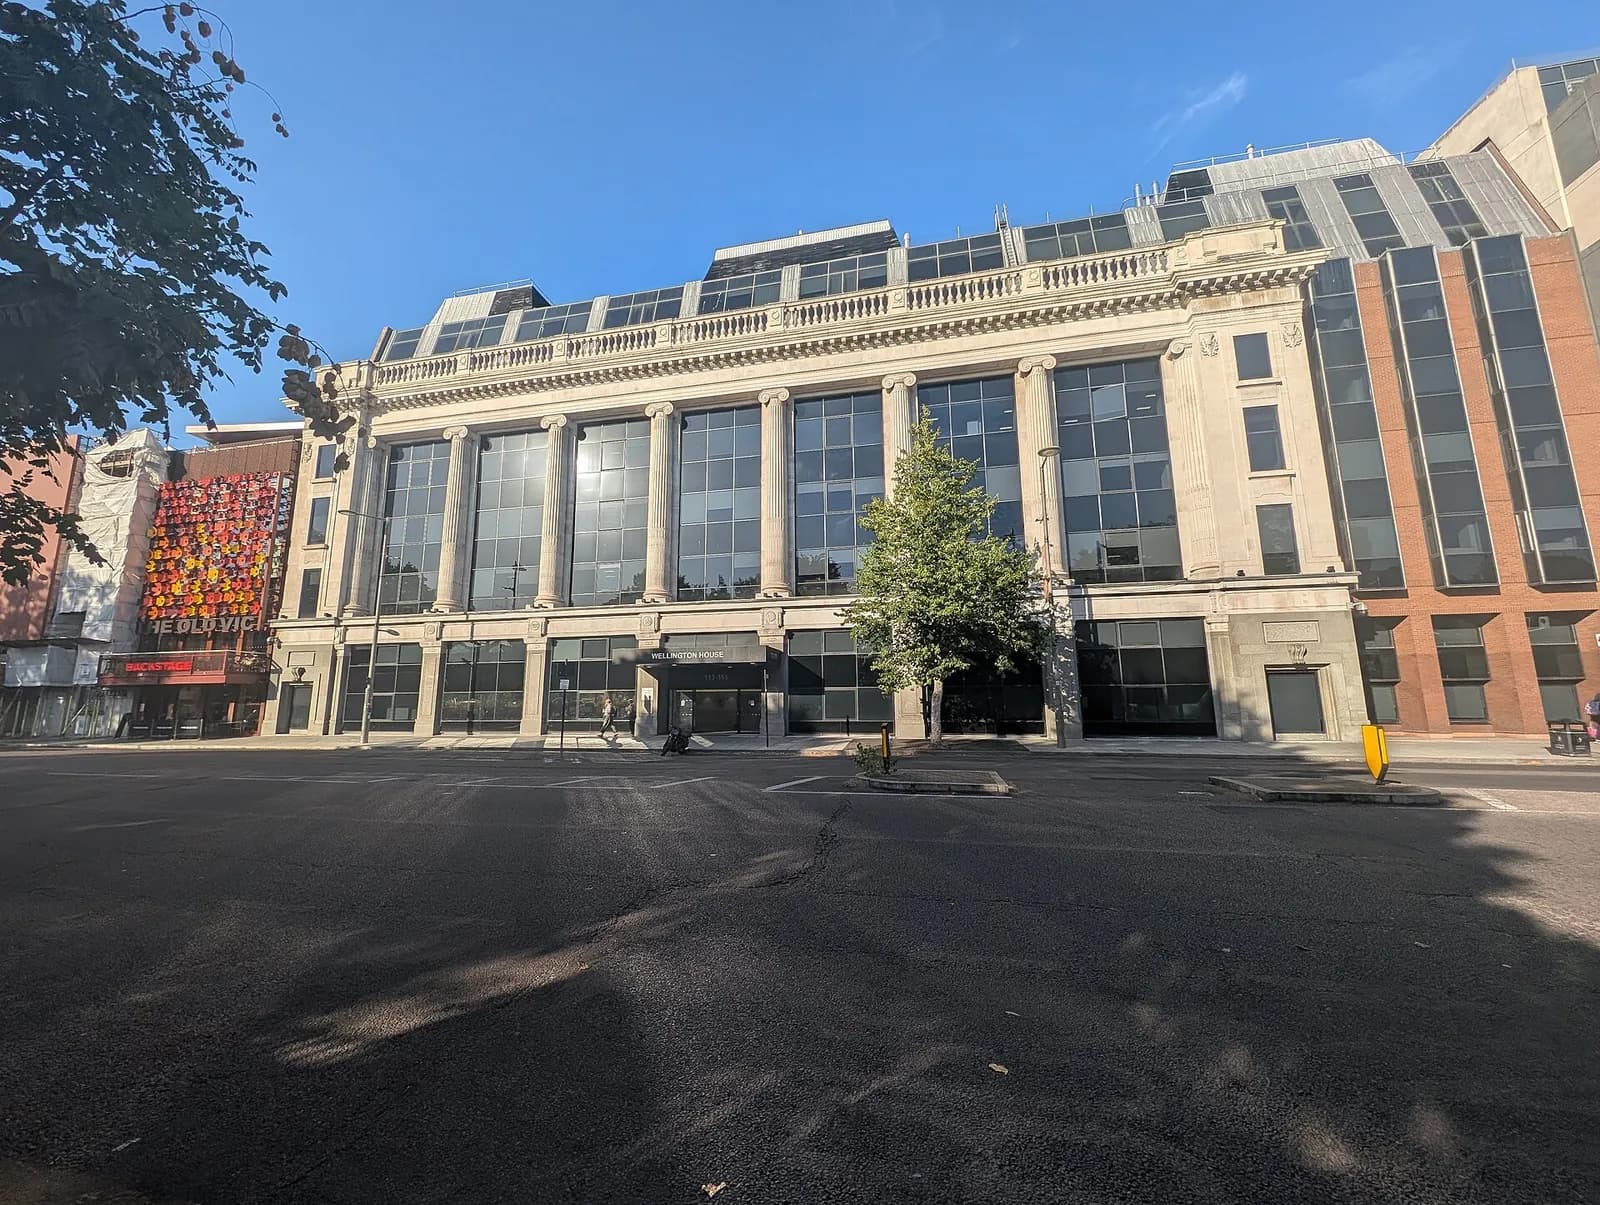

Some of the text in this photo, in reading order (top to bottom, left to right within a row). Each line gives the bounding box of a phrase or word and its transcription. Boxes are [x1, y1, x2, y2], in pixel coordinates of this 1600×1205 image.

[176, 618, 217, 633] OLD
[220, 616, 255, 632] VIC
[125, 661, 193, 671] BACKSTAGE
